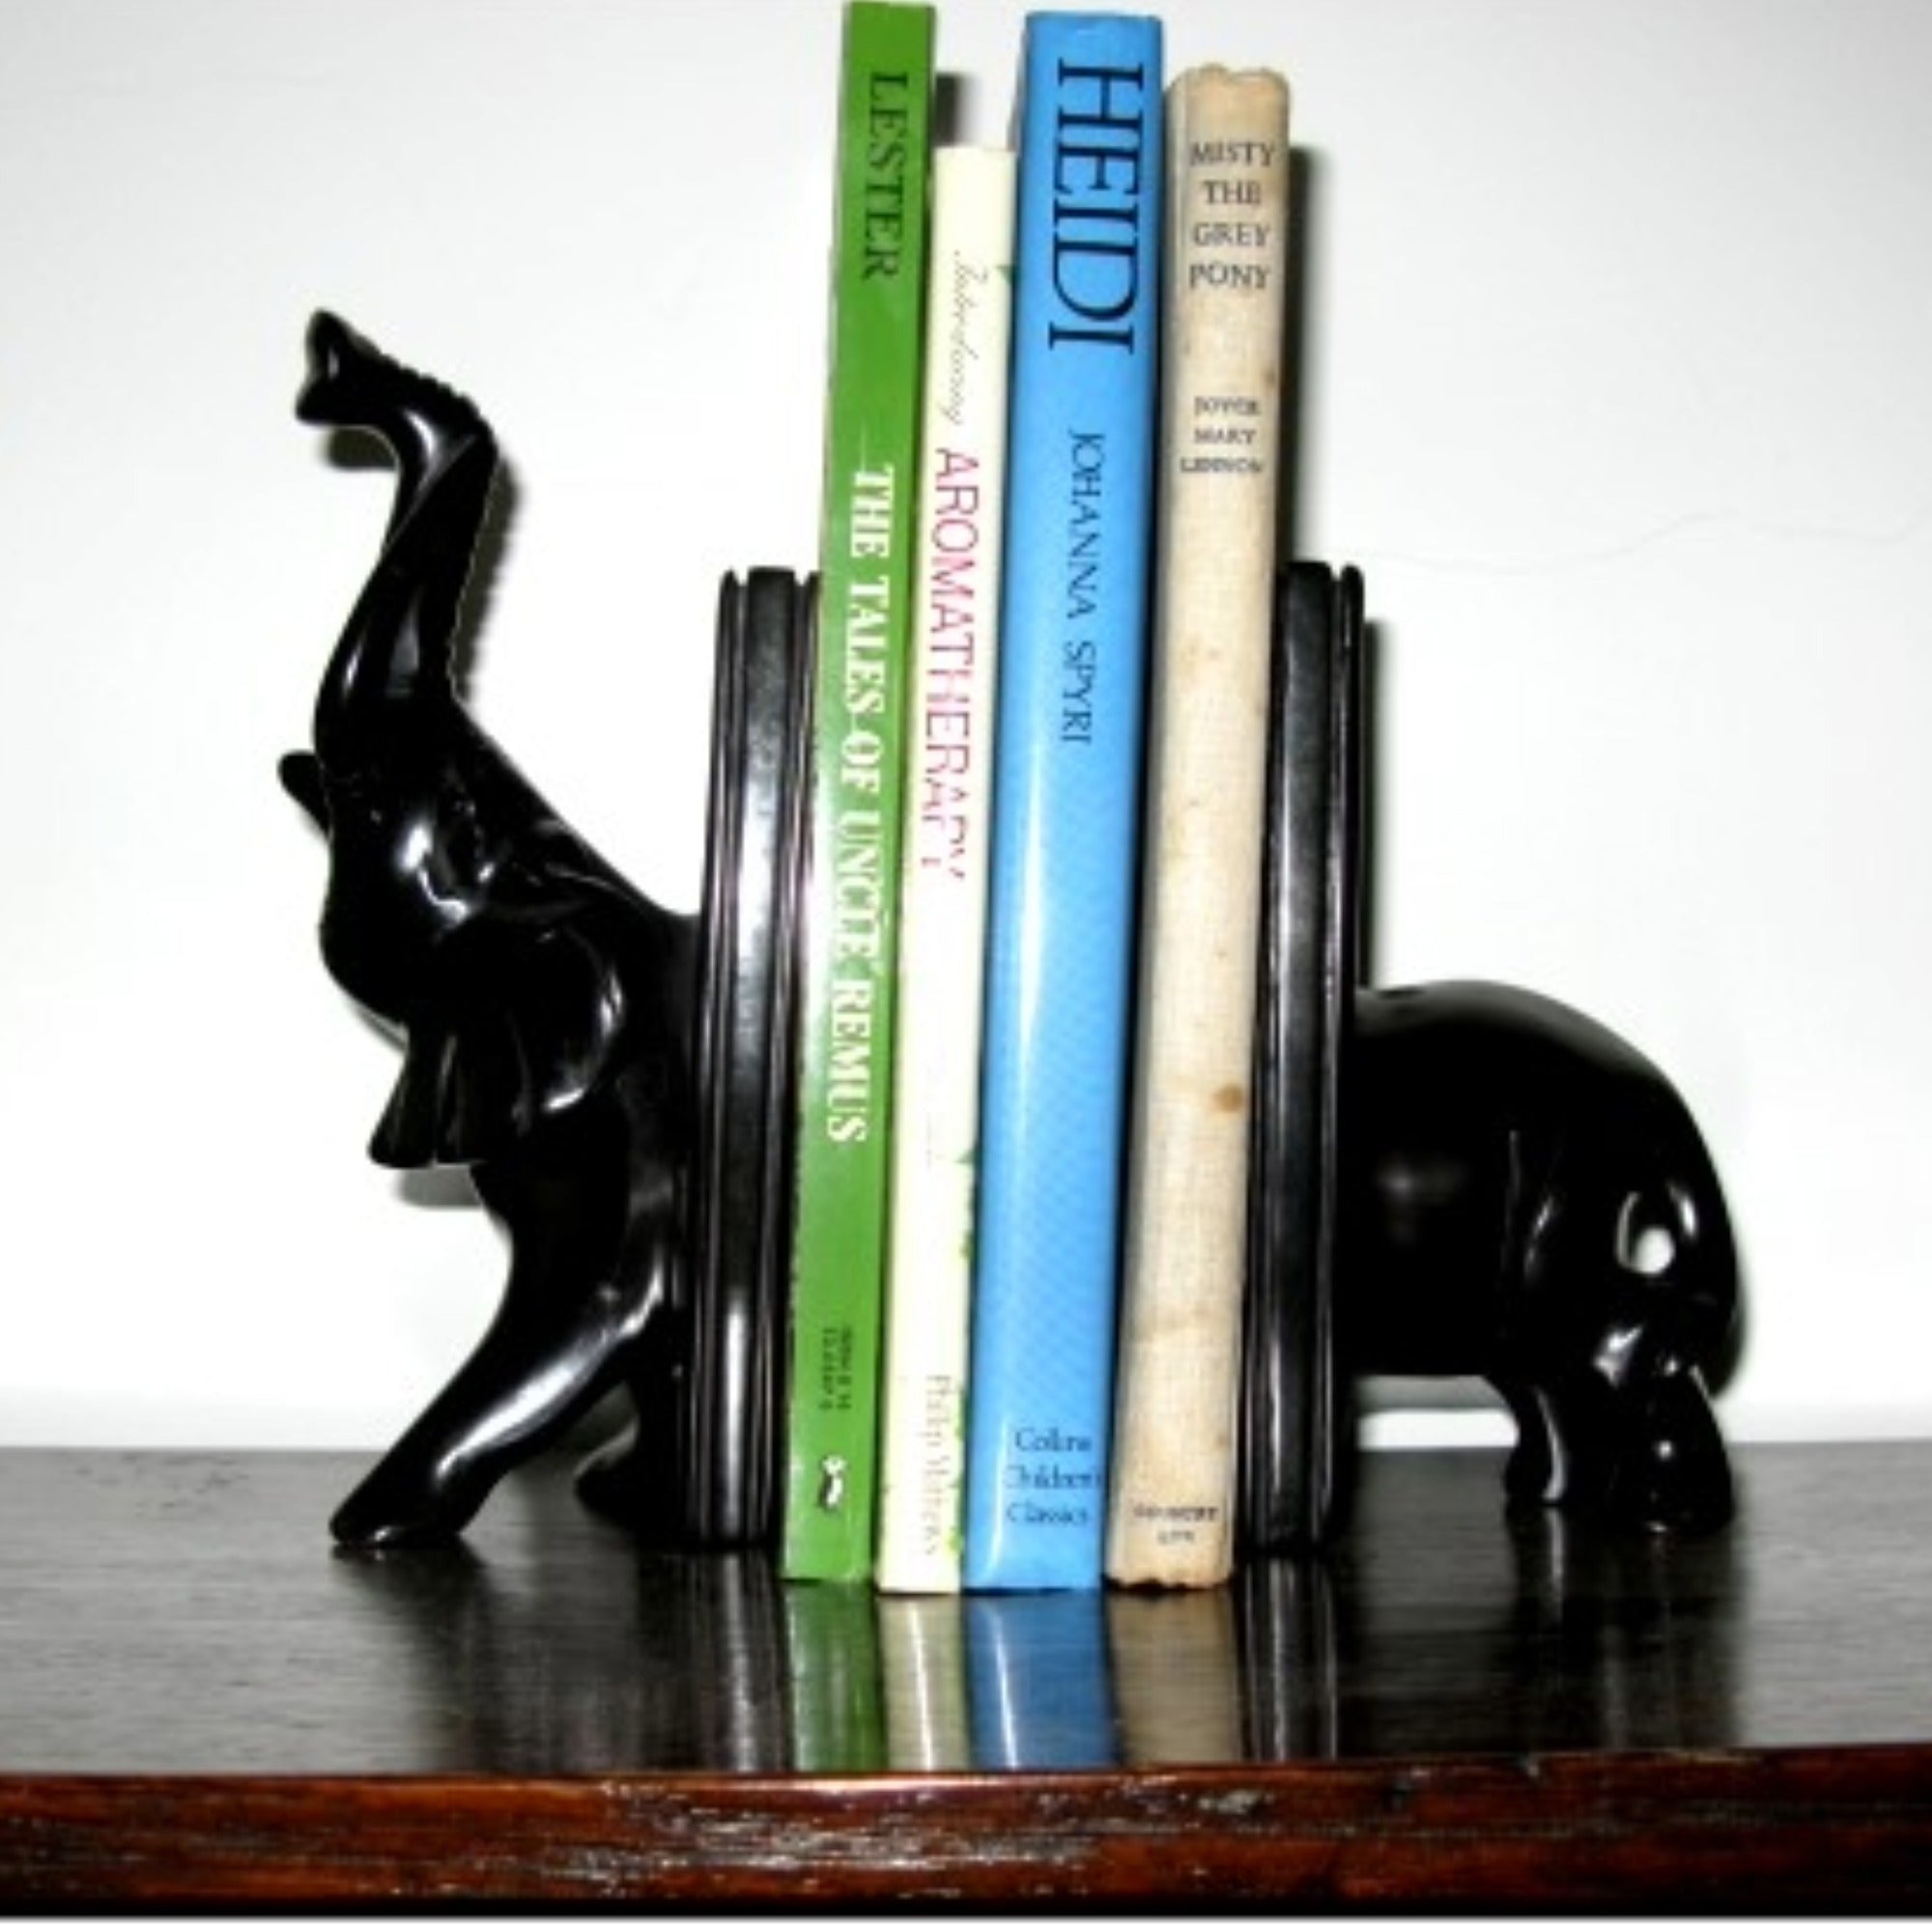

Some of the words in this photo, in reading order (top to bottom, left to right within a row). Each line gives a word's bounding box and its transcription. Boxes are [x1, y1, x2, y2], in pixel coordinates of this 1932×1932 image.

[861, 71, 908, 281] LESTER
[1049, 58, 1145, 354] HEIDI
[1189, 142, 1275, 166] MISTY
[1202, 180, 1262, 205] THE
[1189, 264, 1271, 290] PONY
[1193, 223, 1271, 248] GREY
[850, 465, 895, 557] THE
[1067, 429, 1106, 619] JOHANNA
[844, 579, 891, 715] TALES
[922, 448, 980, 881] AROMATHERAPY
[1062, 640, 1096, 745] SPYRI
[839, 724, 885, 793] OF
[835, 810, 883, 961] UNCLE
[825, 979, 872, 1143] REMUS
